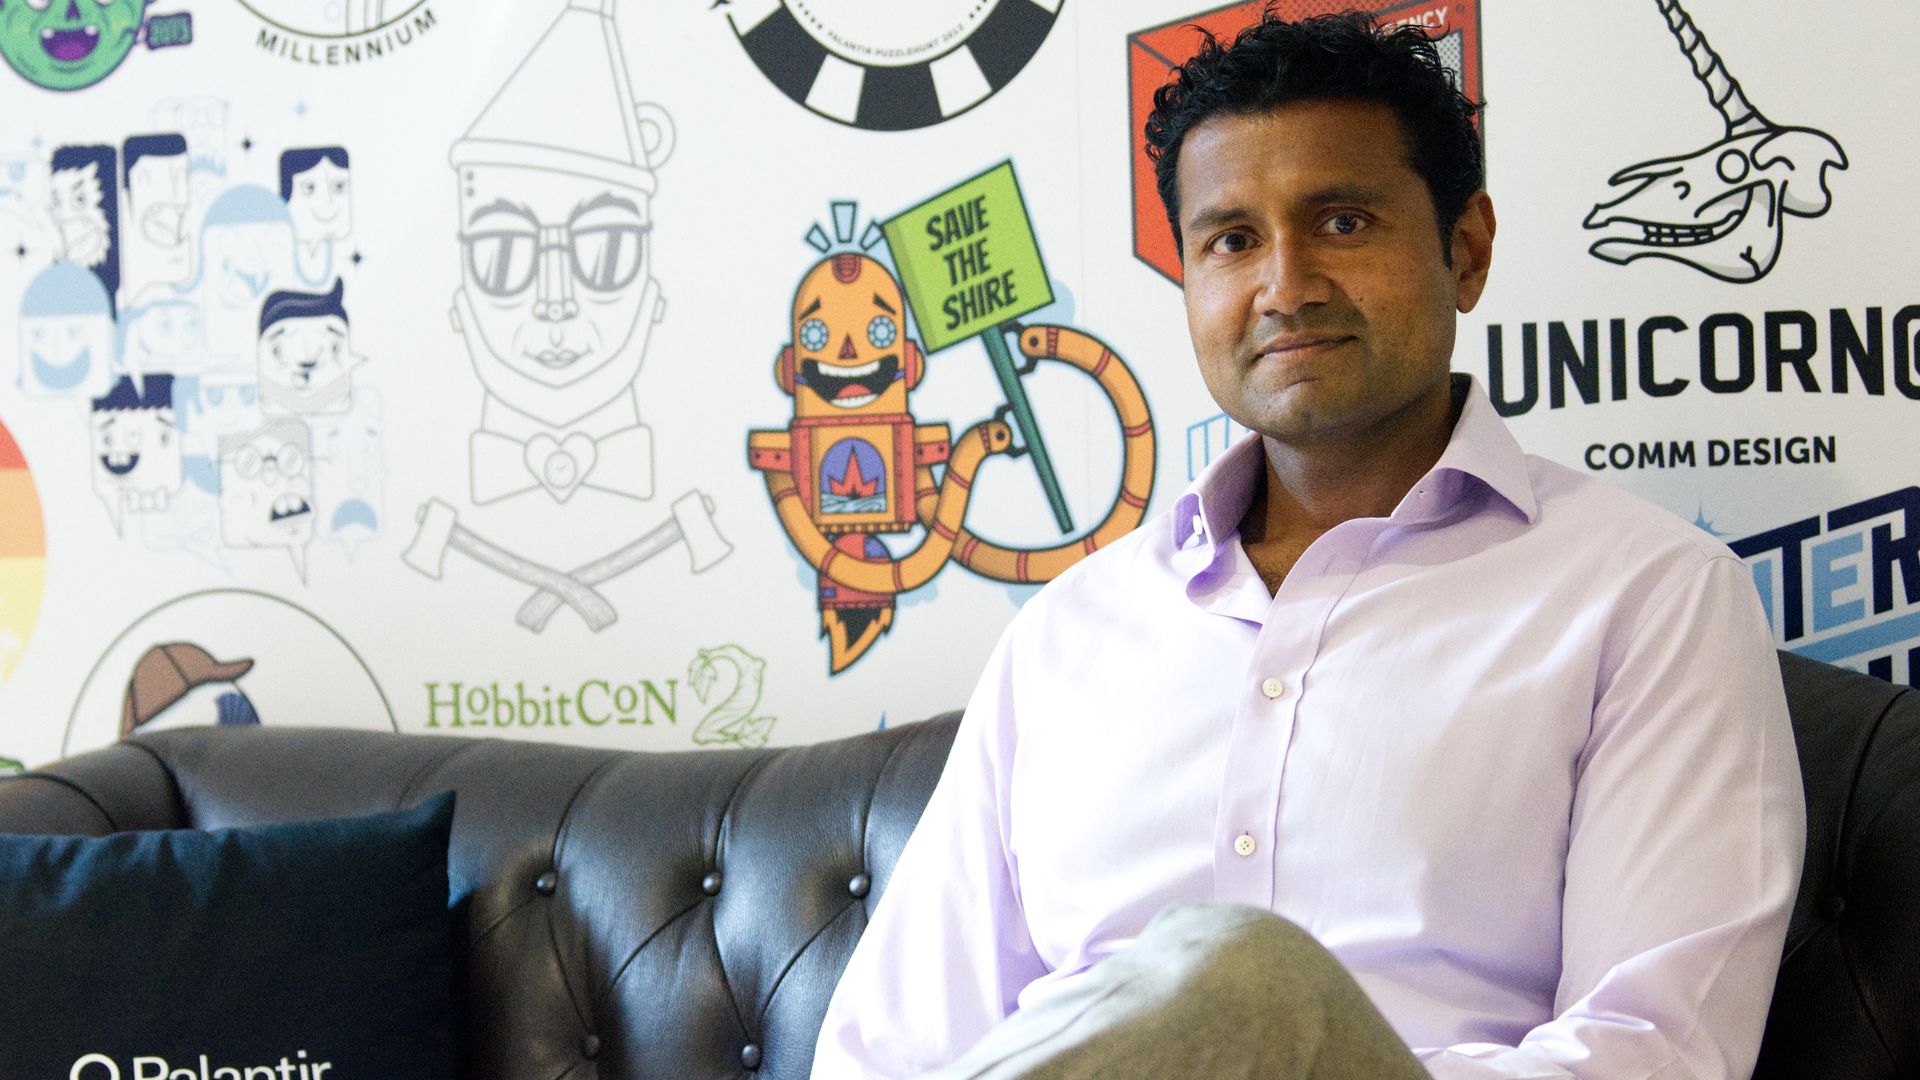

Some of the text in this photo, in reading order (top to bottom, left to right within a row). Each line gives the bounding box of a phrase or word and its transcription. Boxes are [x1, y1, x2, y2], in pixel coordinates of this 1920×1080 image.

[256, 9, 437, 66] MILLENNIUM
[828, 32, 872, 55] PALANTIR
[875, 39, 939, 57] PUZZLEHUNT
[925, 194, 990, 251] SAVE
[943, 237, 991, 287] THE
[942, 268, 1018, 331] SHIRE
[1584, 435, 1836, 471] COMM DESIGN
